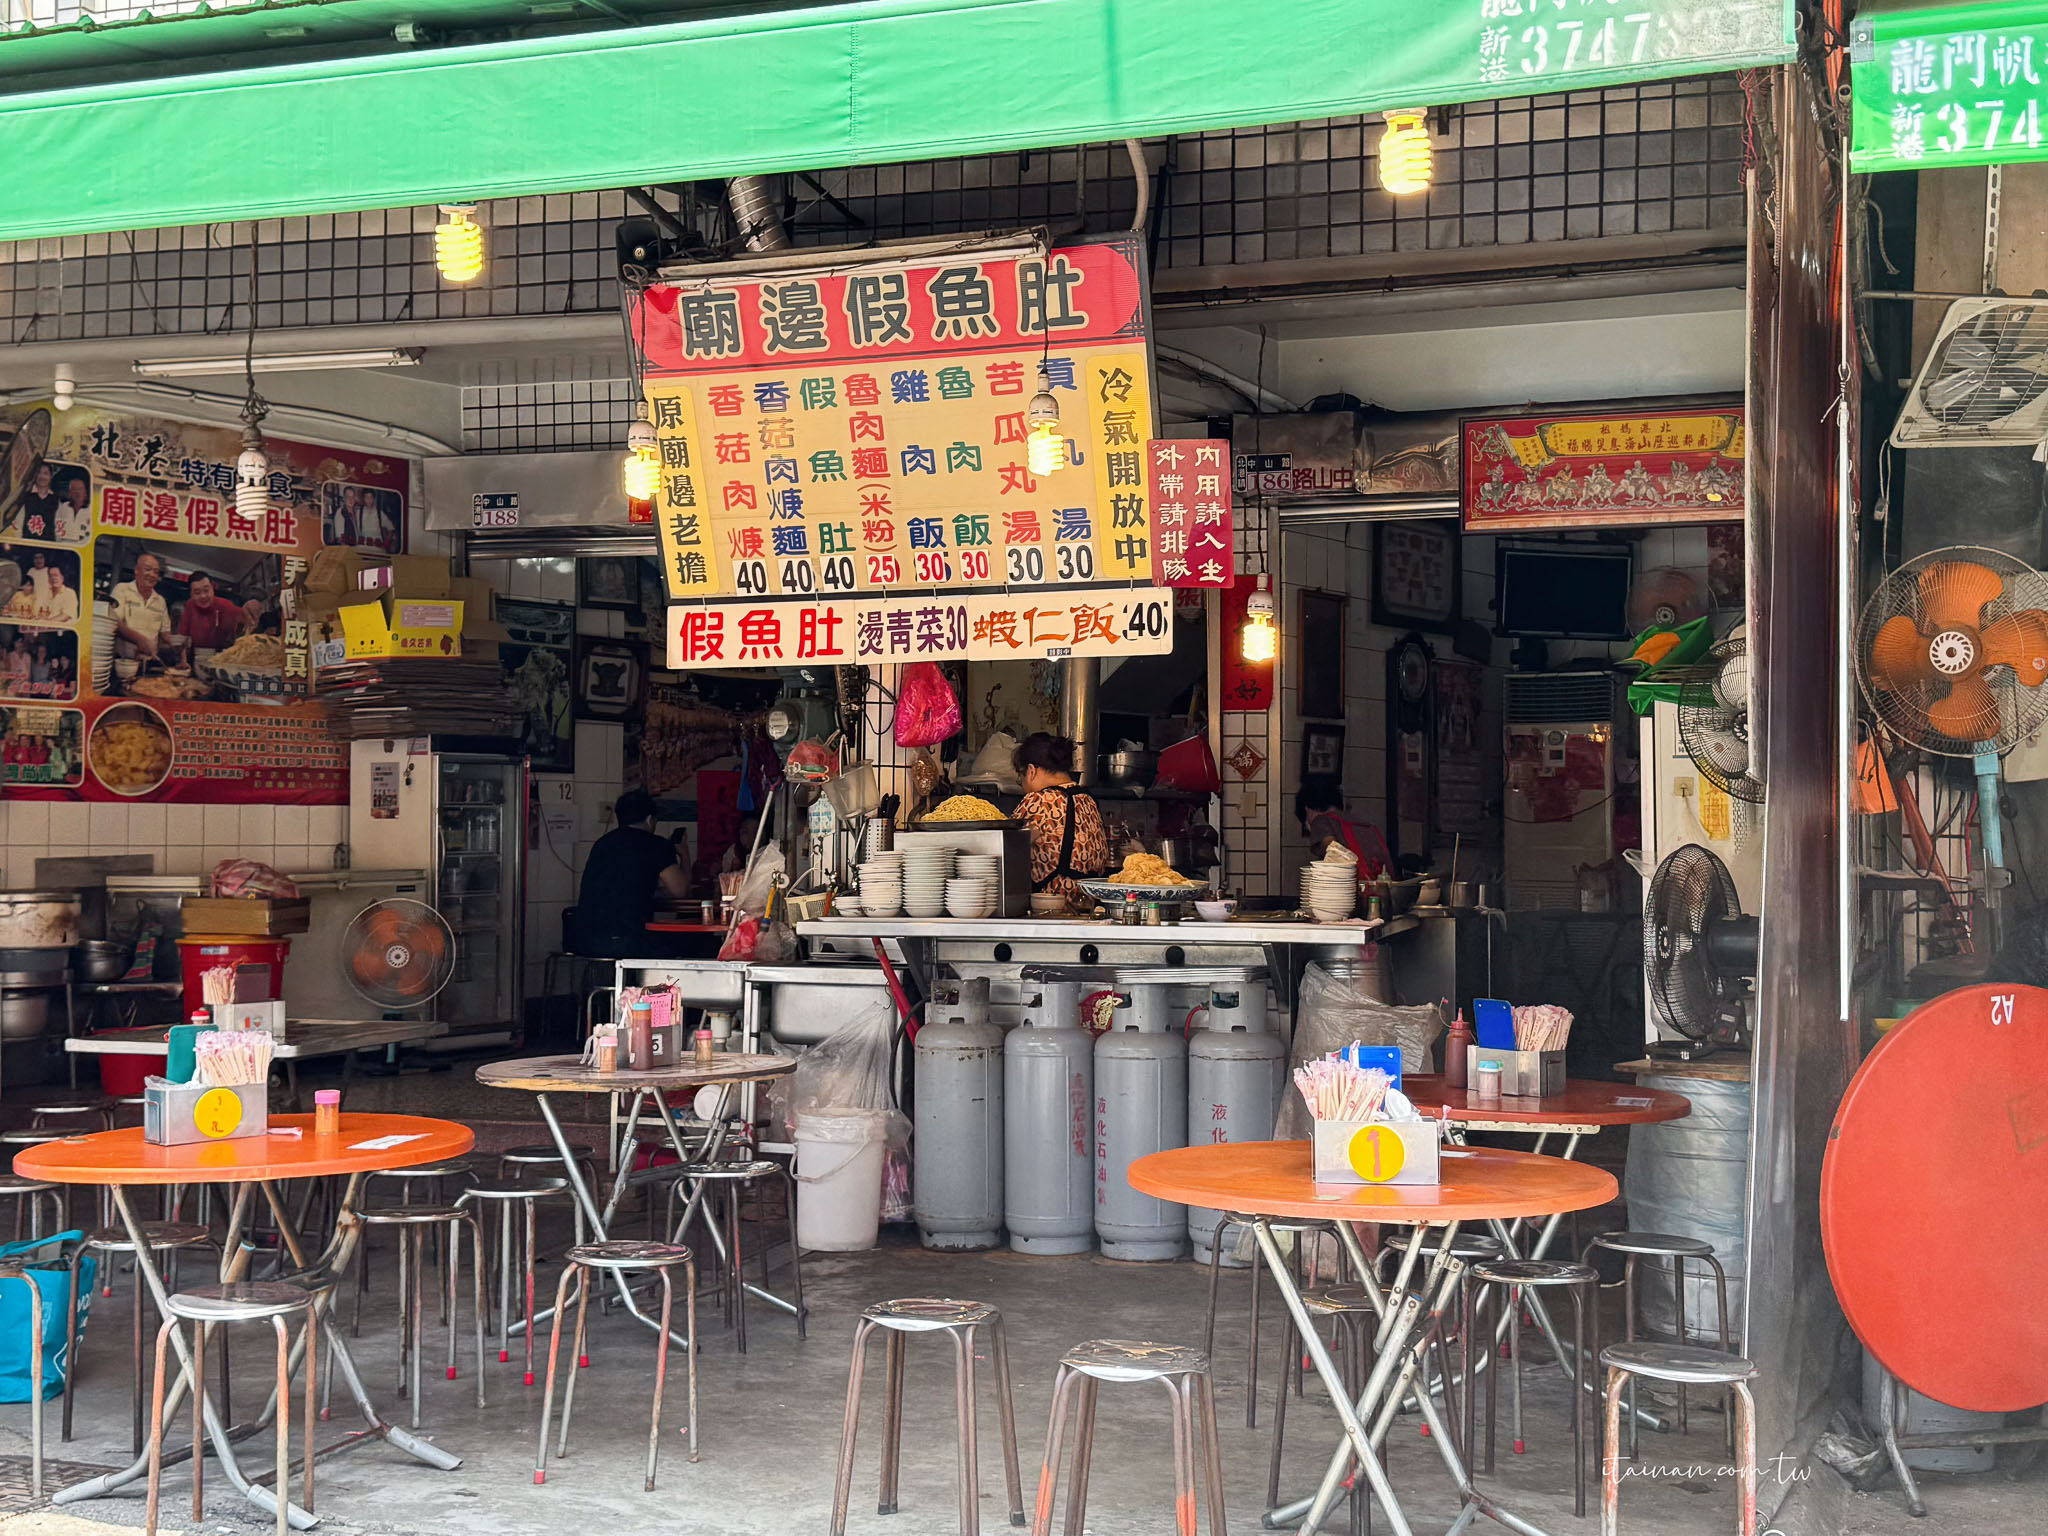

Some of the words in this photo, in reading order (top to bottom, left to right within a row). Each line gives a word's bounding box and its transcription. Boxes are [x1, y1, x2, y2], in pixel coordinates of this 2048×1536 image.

[1521, 12, 1676, 74] 3747
[1891, 34, 2048, 95] 龍門帆
[1937, 99, 2042, 152] 374
[682, 257, 1088, 358] 廟邊假魚肚
[91, 421, 168, 477] 北港
[800, 377, 856, 554] 假魚肚
[891, 369, 946, 549] 雞肉飯
[935, 366, 992, 546] 魯肉飯
[985, 361, 1041, 544] 苦瓜丸湯
[1099, 368, 1147, 569] 冷氣開放中
[1247, 457, 1290, 469] 中山路
[180, 457, 292, 498] 特有食
[653, 396, 707, 584] 原廟邊老擔
[1247, 473, 1290, 490] 186
[100, 486, 299, 545] 廟邊假魚肚
[485, 510, 517, 525] 188
[1155, 445, 1192, 581] 外帶請排隊
[1195, 445, 1226, 583] 內用請入坐
[737, 561, 767, 593] 40
[782, 560, 812, 592] 40
[824, 557, 854, 589] 40
[870, 555, 895, 583] 25
[917, 553, 943, 581] 30
[962, 551, 989, 579] 30
[1008, 548, 1043, 581] 30
[1057, 545, 1092, 579] 30
[680, 607, 843, 661] 假魚肚
[973, 602, 1121, 648] 蝦仁飯
[1129, 602, 1162, 637] 40
[559, 783, 571, 800] 12
[1990, 994, 2015, 1026] A2
[1212, 1104, 1228, 1144] 液化
[1368, 1129, 1380, 1178] 1
